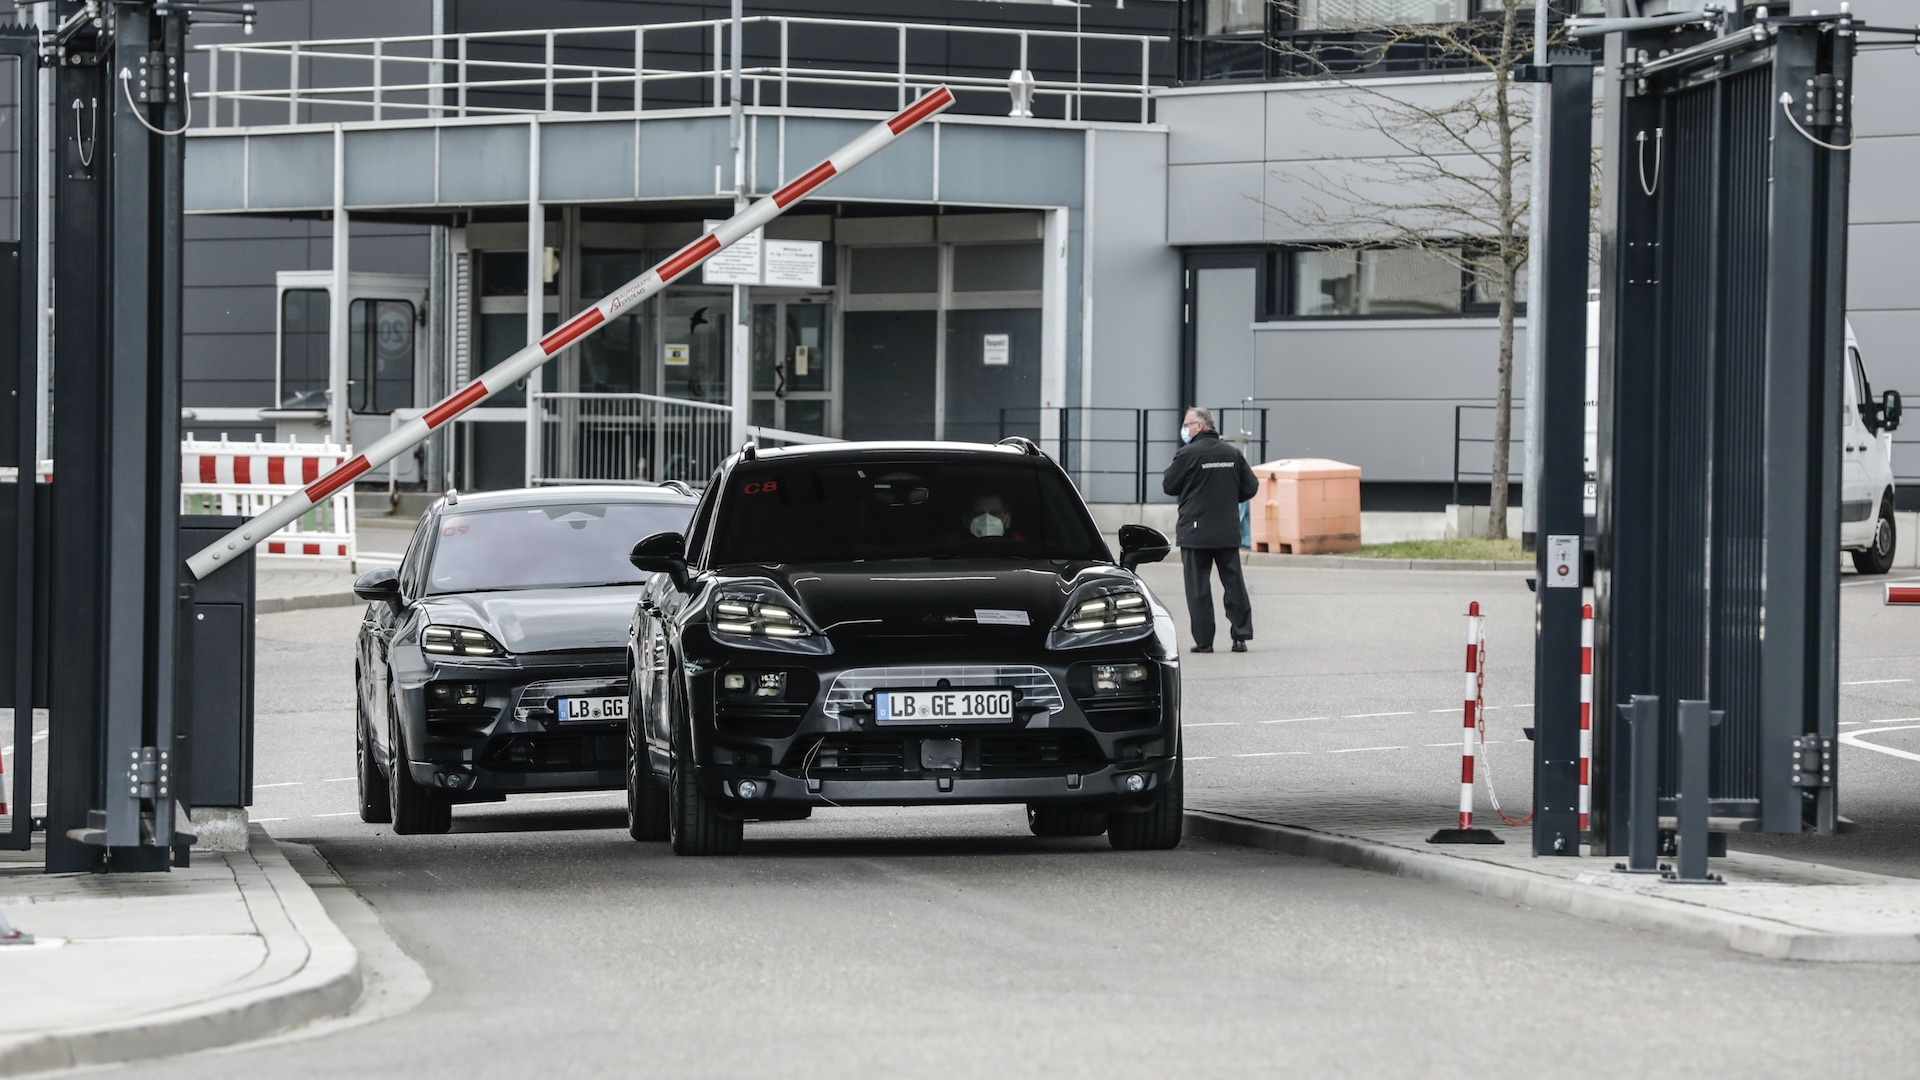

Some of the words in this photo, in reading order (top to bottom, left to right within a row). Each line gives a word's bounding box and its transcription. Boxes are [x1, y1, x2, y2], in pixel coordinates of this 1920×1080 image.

[619, 275, 654, 300] AUTOMATIC
[621, 287, 646, 306] SYSTEMS
[743, 481, 778, 494] C8
[442, 524, 470, 537] C9
[569, 700, 590, 718] LB
[602, 699, 623, 717] GG
[891, 696, 916, 717] LB
[931, 695, 957, 716] GE
[961, 694, 1010, 715] 1800
